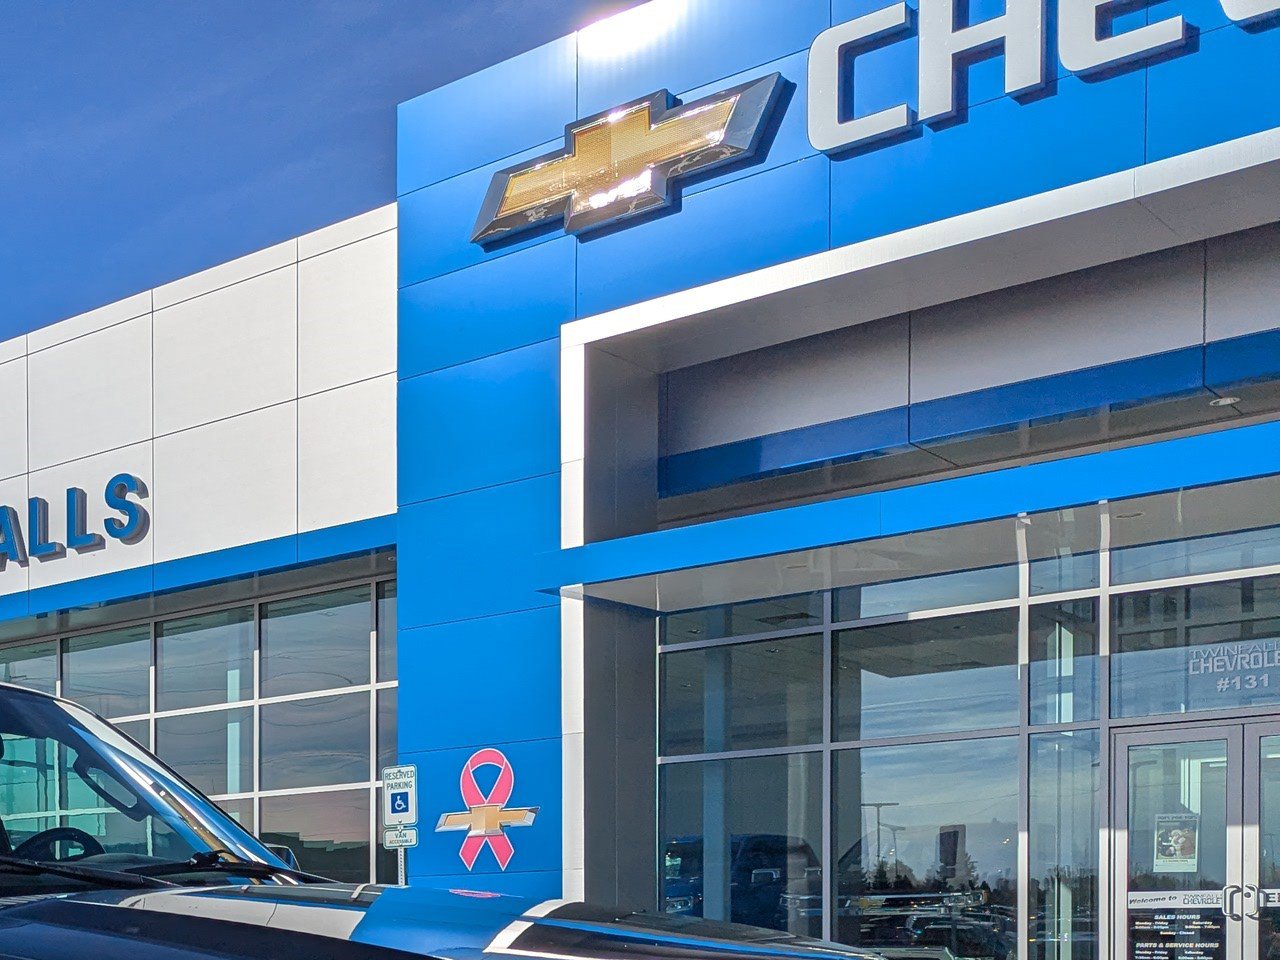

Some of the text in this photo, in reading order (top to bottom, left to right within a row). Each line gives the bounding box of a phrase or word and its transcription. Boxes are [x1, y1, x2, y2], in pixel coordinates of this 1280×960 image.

[807, 0, 1280, 154] CH
[1216, 673, 1269, 692] #131
[384, 770, 415, 781] RESERVED
[386, 780, 413, 791] PARKING
[1129, 896, 1167, 905] Welcome
